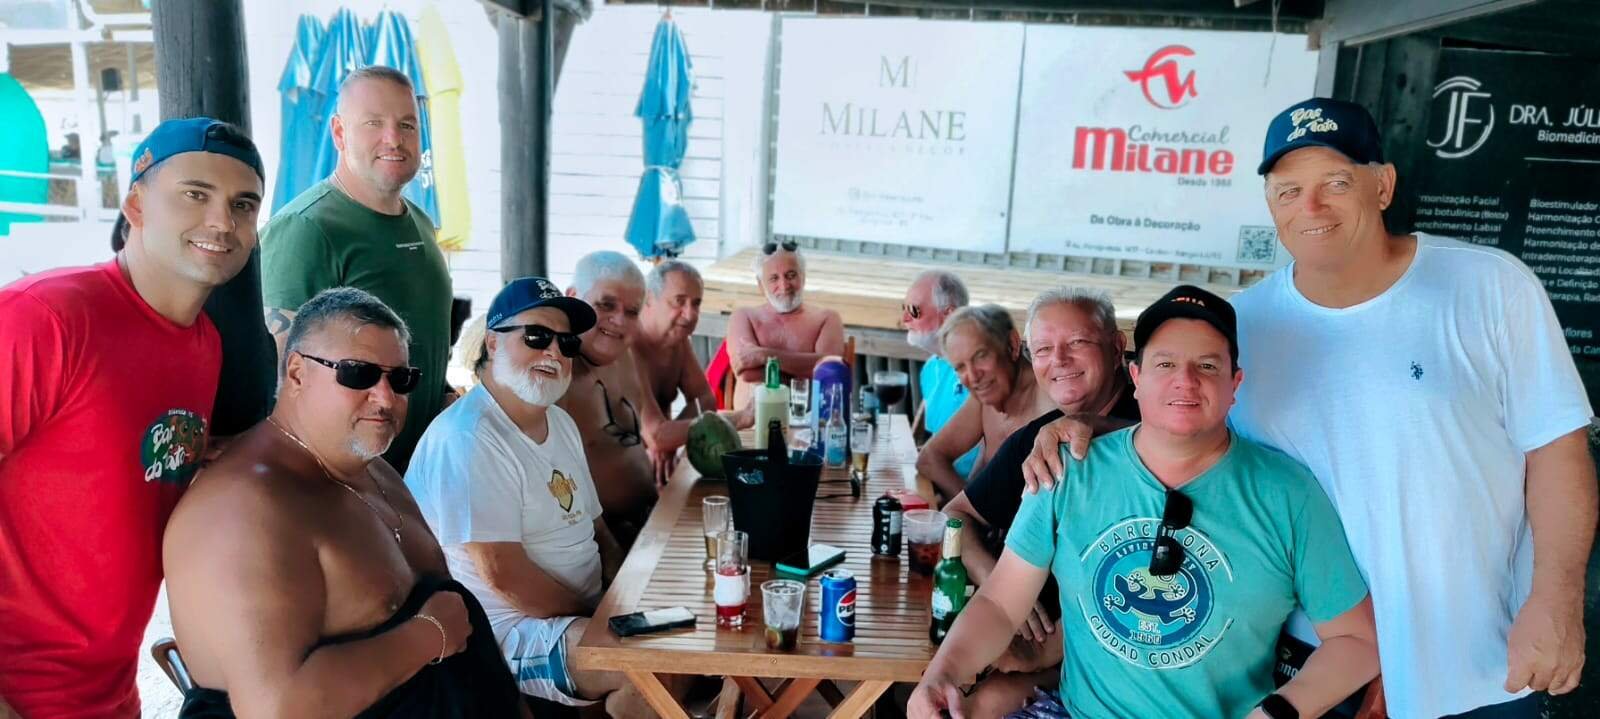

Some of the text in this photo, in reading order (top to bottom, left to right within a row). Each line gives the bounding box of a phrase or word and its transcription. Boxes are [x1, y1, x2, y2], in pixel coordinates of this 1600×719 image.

[819, 102, 967, 141] MILANE
[1509, 104, 1554, 126] DRA.
[1127, 124, 1230, 145] Comercial
[1472, 196, 1500, 206] Facial
[1529, 199, 1598, 211] Bioestimulador
[1106, 215, 1132, 227] Obra
[1143, 217, 1201, 233] Decoração
[1528, 212, 1593, 225] Harmonização
[1473, 223, 1502, 233] Labial
[1525, 225, 1596, 237] Preenchimento
[1523, 238, 1588, 251] Harmonização
[1556, 279, 1600, 290] Definição
[1099, 523, 1219, 571] BARCONA
[1090, 615, 1139, 661] CIUDAD
[1148, 635, 1215, 667] CONDAL
